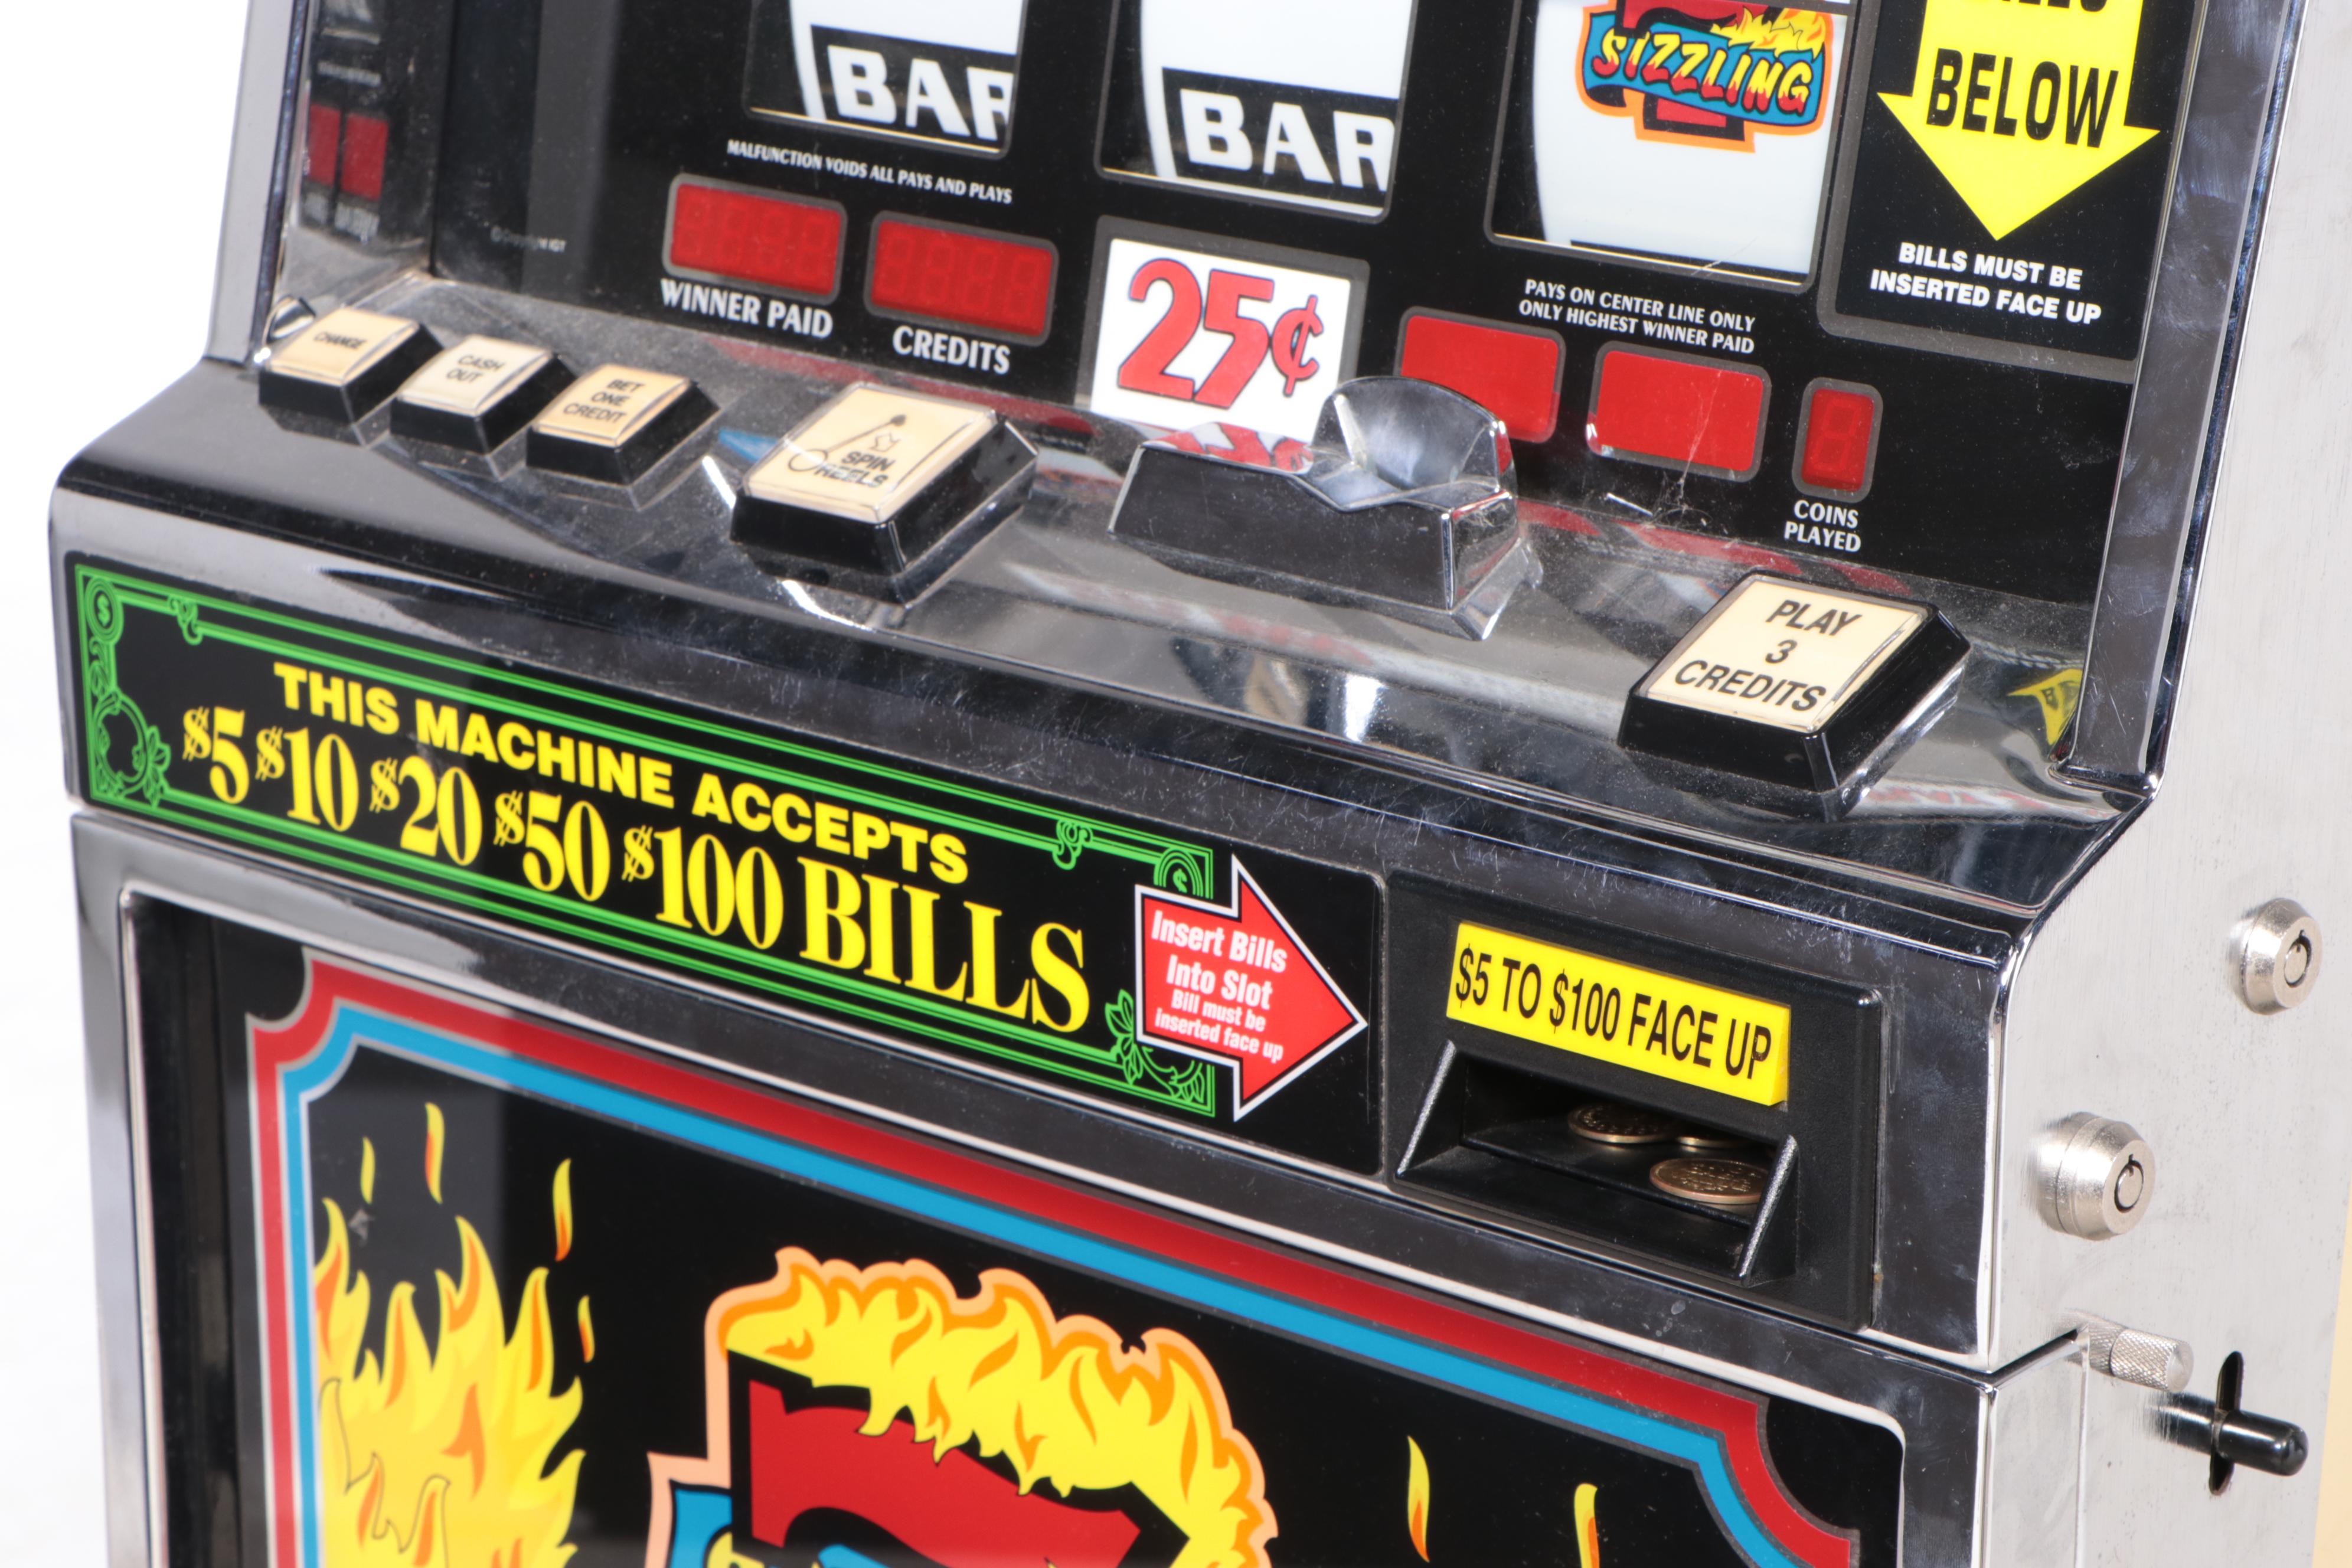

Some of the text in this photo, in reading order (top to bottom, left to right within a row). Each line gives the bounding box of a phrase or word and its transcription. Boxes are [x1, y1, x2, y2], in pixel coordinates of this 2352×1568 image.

[828, 45, 1014, 141] BAR
[1589, 27, 1813, 115] SIZZLING
[1926, 48, 2118, 148] BELOW
[1180, 89, 1396, 191] BAR
[727, 139, 1012, 204] MALFUNCTION VOIDS ALL PAYS AND PLAYS
[1899, 242, 2083, 290] BILLS MUST BE
[661, 278, 832, 338] WINNER PAID
[1525, 279, 1755, 332] PAYS ON CENTER LINE ONLY
[1870, 269, 2102, 324] INSERTED FACE UP
[313, 332, 367, 349] CHANGE
[893, 326, 1010, 374] CREDITS
[1118, 258, 1324, 409] 25¢
[1519, 299, 1754, 354] ONLY HIGHEST WINNER PAID
[446, 368, 483, 381] OUT
[458, 354, 505, 371] CASH
[607, 380, 645, 392] BET
[563, 403, 627, 423] CREDIT
[591, 392, 630, 406] ONE
[841, 451, 896, 471] SPIN
[1783, 521, 1861, 553] PLAYED
[1794, 499, 1858, 529] COINS
[1766, 599, 1861, 636] PLAY
[1765, 639, 1795, 664] 3
[1675, 659, 1827, 711] CREDITS
[274, 662, 969, 884] THIS MACHINE ACCEPTS
[183, 706, 1090, 1033] $5 $10 $20 $50 $100 BILLS
[1151, 910, 1288, 973] Insert Bills
[1167, 955, 1273, 1010] Into Slot
[1155, 1008, 1284, 1064] inserted face up
[1171, 989, 1266, 1033] Bill must be
[1455, 943, 1772, 1080] $5 TO $100 FACE UP
